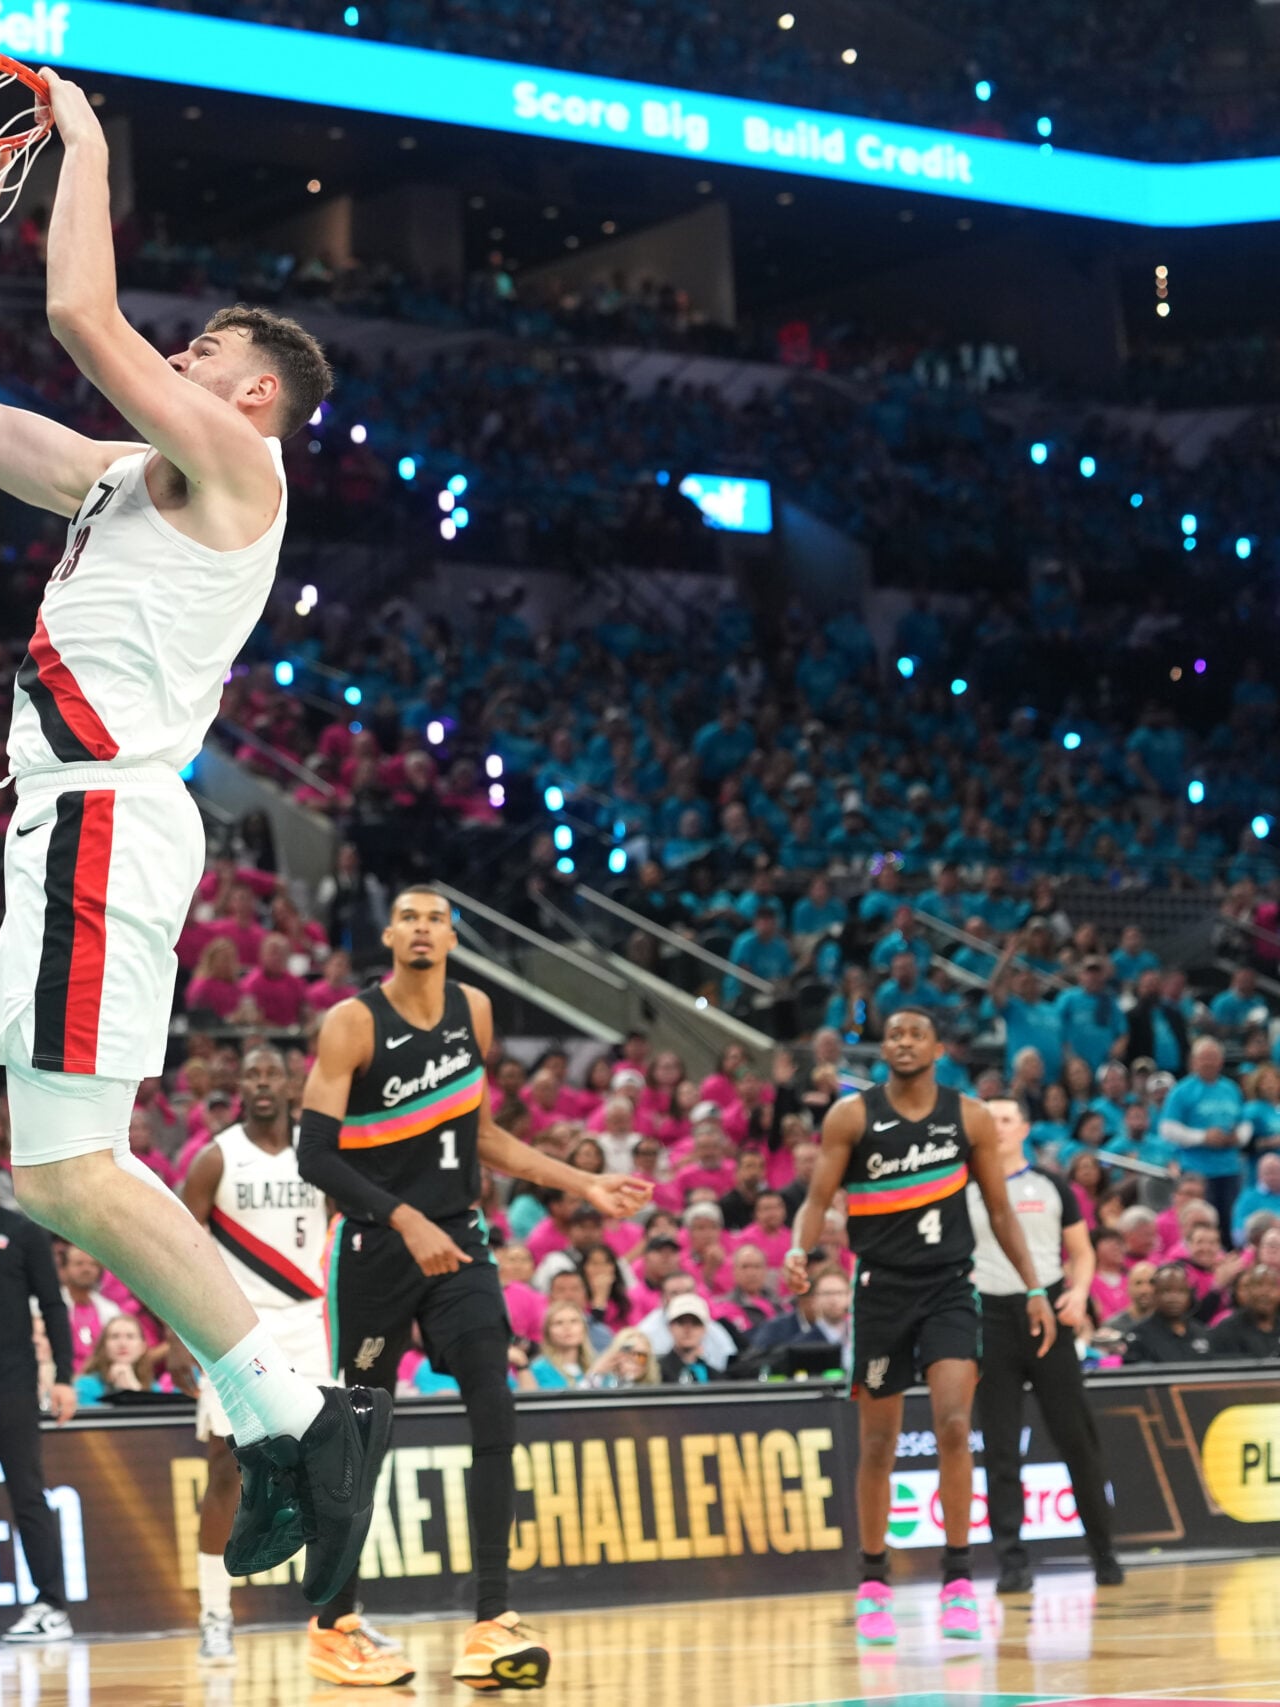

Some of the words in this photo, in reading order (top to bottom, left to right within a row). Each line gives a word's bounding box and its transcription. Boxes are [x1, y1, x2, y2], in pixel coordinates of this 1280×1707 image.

[512, 80, 631, 132] Score
[640, 100, 710, 152] Big
[742, 116, 847, 164] Build
[855, 133, 973, 184] Credit
[382, 1075, 420, 1108] San
[419, 1047, 472, 1091] Antonio
[439, 1130, 460, 1170] 1
[866, 1152, 900, 1180] San
[900, 1139, 960, 1172] Antonio
[295, 1216, 306, 1249] 5
[917, 1208, 943, 1245] 4
[507, 1429, 843, 1571] CHALLENGE
